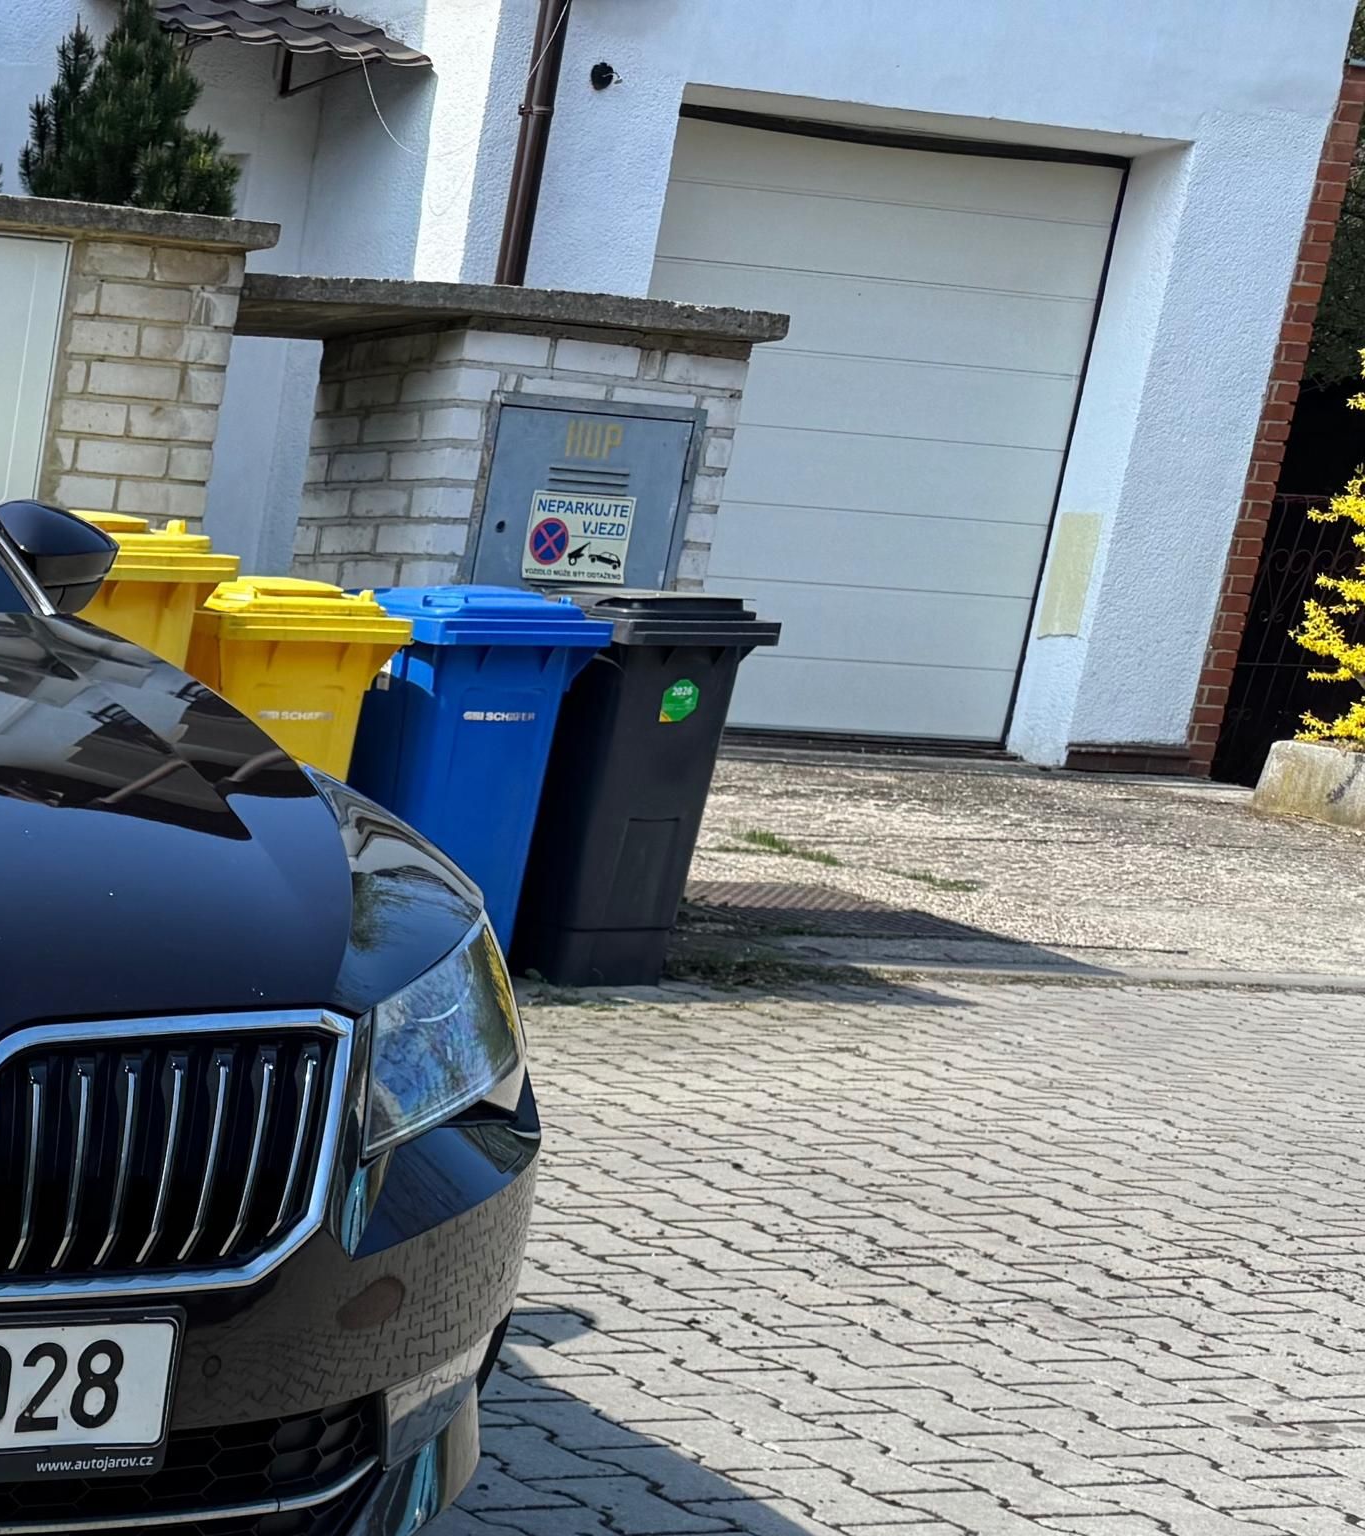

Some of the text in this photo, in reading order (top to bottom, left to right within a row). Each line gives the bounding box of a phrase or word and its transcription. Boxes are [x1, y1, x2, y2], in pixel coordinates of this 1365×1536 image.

[537, 499, 630, 518] NEPARKUJTE
[583, 521, 626, 537] VJEZD
[36, 1456, 154, 1472] www.autojarov.cz
